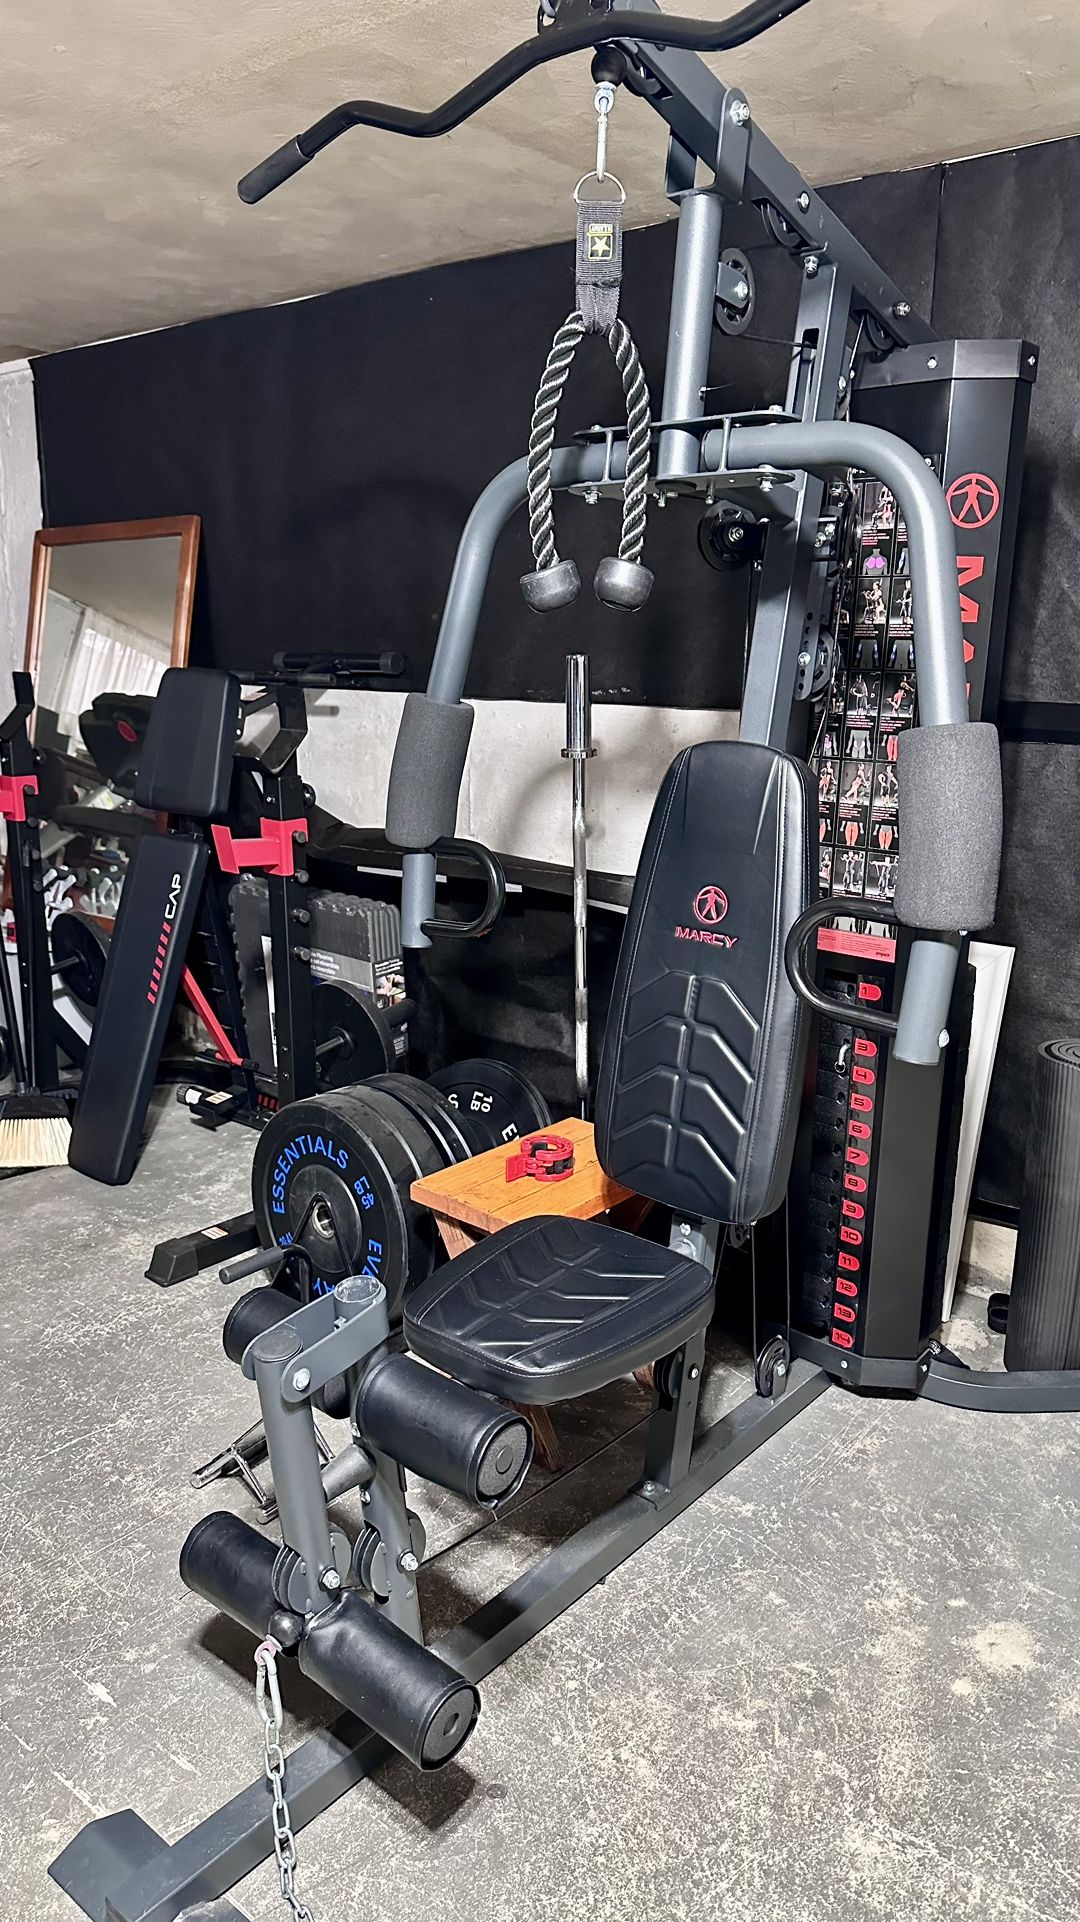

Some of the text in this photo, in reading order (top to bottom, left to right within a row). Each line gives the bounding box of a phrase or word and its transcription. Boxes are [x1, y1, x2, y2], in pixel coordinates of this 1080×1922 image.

[164, 873, 182, 920] CAP
[674, 926, 738, 949] MARCY
[857, 1042, 869, 1053] 3
[855, 1069, 869, 1080] 4
[470, 1090, 484, 1112] LB
[480, 1095, 494, 1113] 10
[853, 1097, 865, 1108] 5
[851, 1124, 863, 1135] 6
[849, 1150, 861, 1160] 7
[272, 1134, 349, 1215] ESSENTIALS
[353, 1175, 371, 1196] LB
[847, 1177, 859, 1188] 8
[361, 1192, 375, 1210] 45
[845, 1203, 857, 1214] 9
[843, 1230, 859, 1241] 10
[841, 1255, 853, 1267] 11
[839, 1281, 853, 1293] 12
[837, 1306, 852, 1319] 13
[835, 1331, 851, 1345] 14
